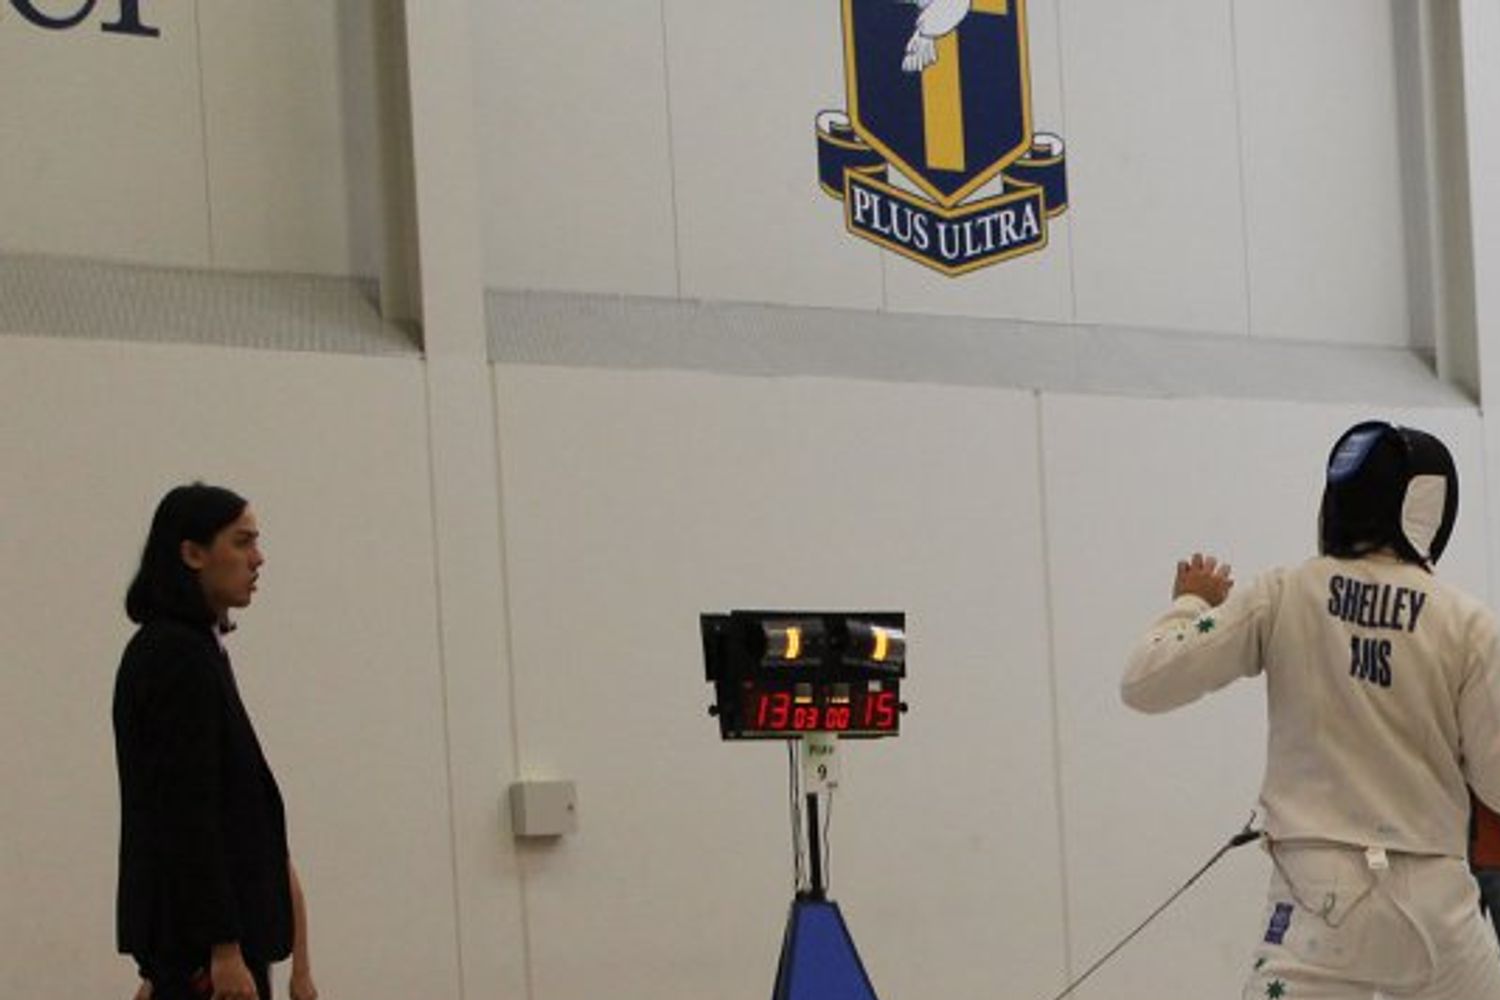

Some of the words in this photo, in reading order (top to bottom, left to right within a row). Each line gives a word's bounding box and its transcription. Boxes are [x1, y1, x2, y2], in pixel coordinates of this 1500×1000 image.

[852, 185, 929, 250] PLUS
[937, 202, 1040, 260] ULTRA
[1327, 574, 1428, 633] SHELLEY
[758, 691, 791, 729] 13
[864, 691, 895, 728] 15
